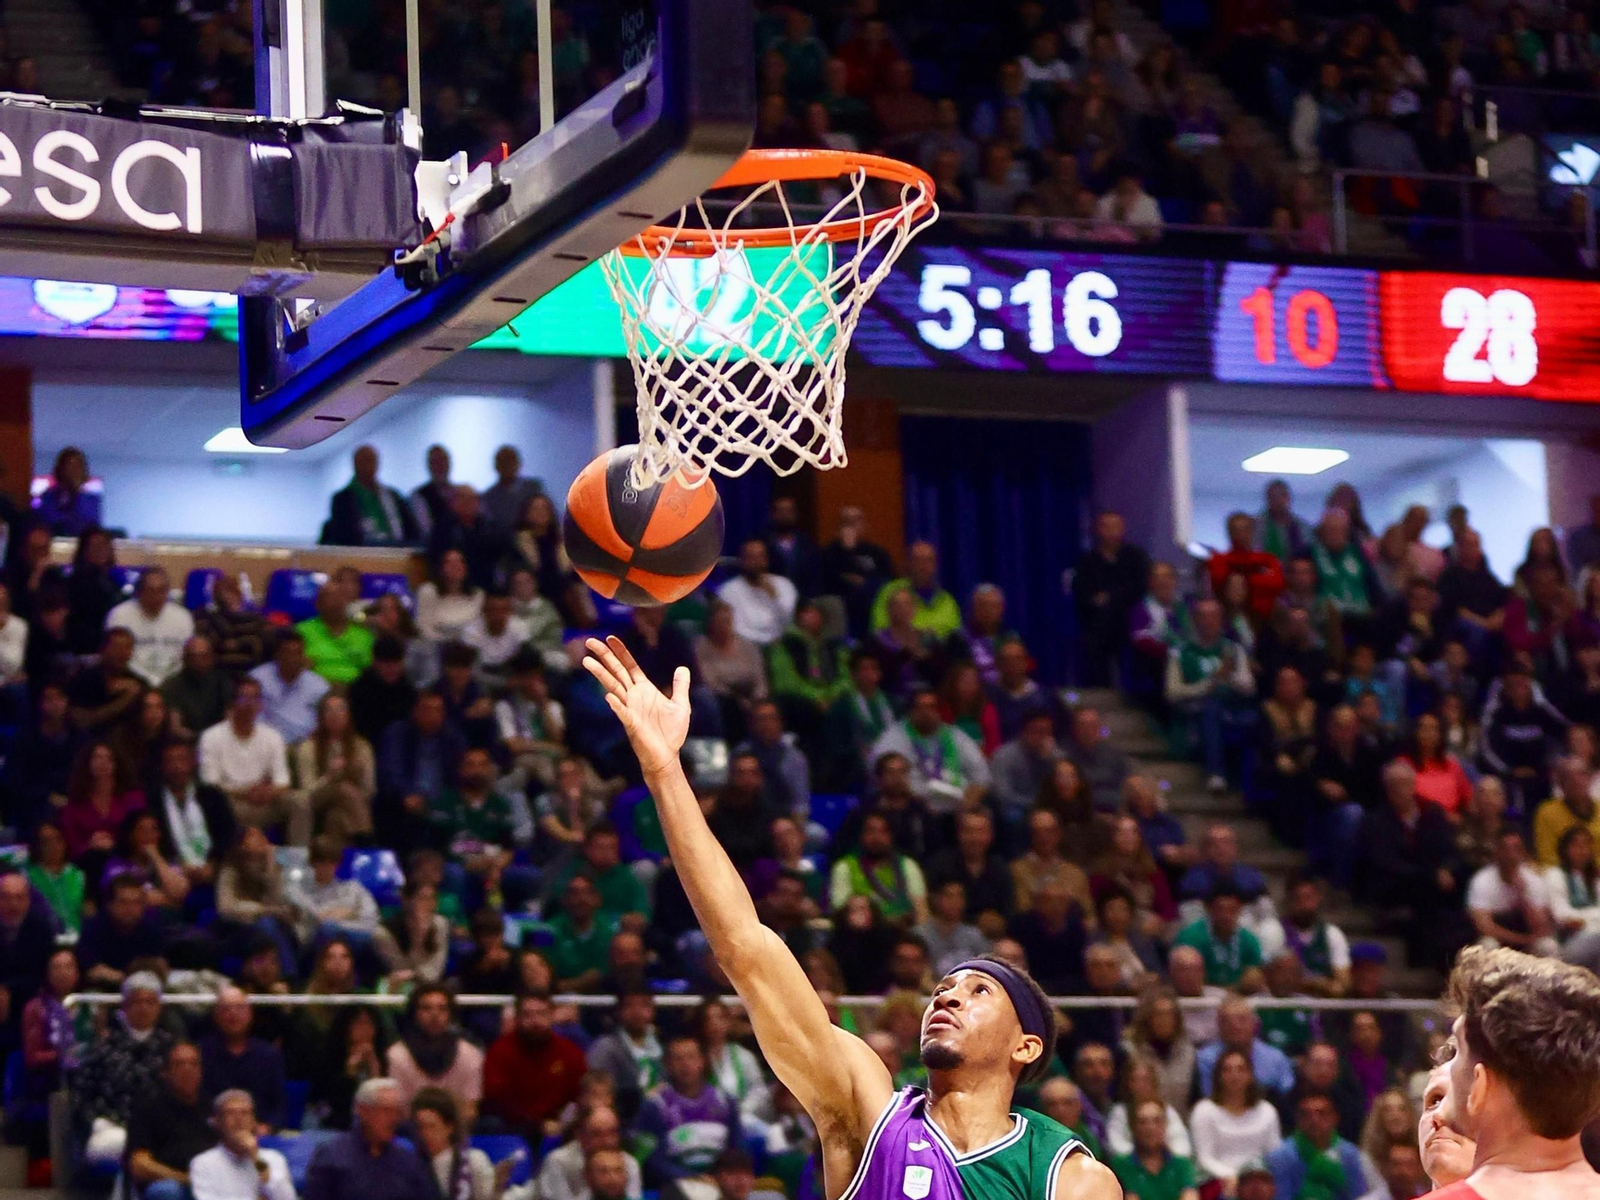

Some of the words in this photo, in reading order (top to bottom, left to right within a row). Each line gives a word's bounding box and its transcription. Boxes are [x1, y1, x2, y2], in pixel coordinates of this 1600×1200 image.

[917, 264, 1122, 357] 5:16
[1241, 286, 1339, 370] 10
[1440, 287, 1539, 386] 28
